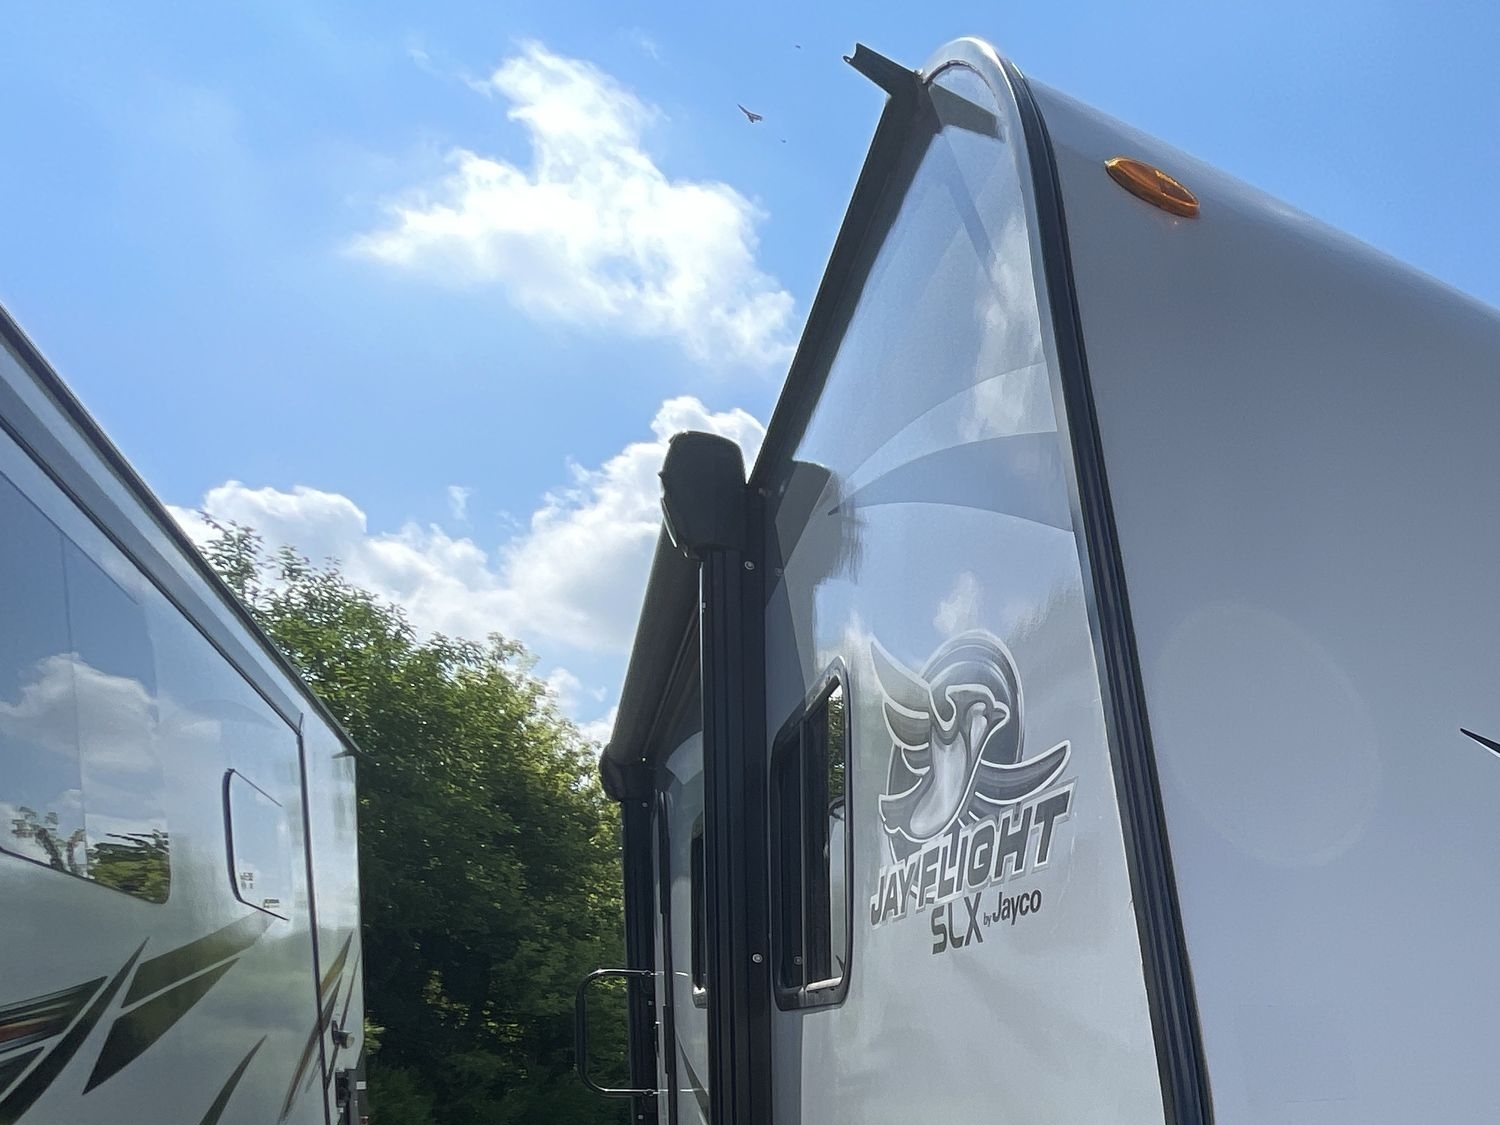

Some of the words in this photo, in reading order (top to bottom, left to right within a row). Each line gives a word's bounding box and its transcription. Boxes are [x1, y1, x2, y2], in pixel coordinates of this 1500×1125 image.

[931, 893, 983, 955] SLX
[983, 912, 992, 927] by
[992, 890, 1042, 926] Jayco
